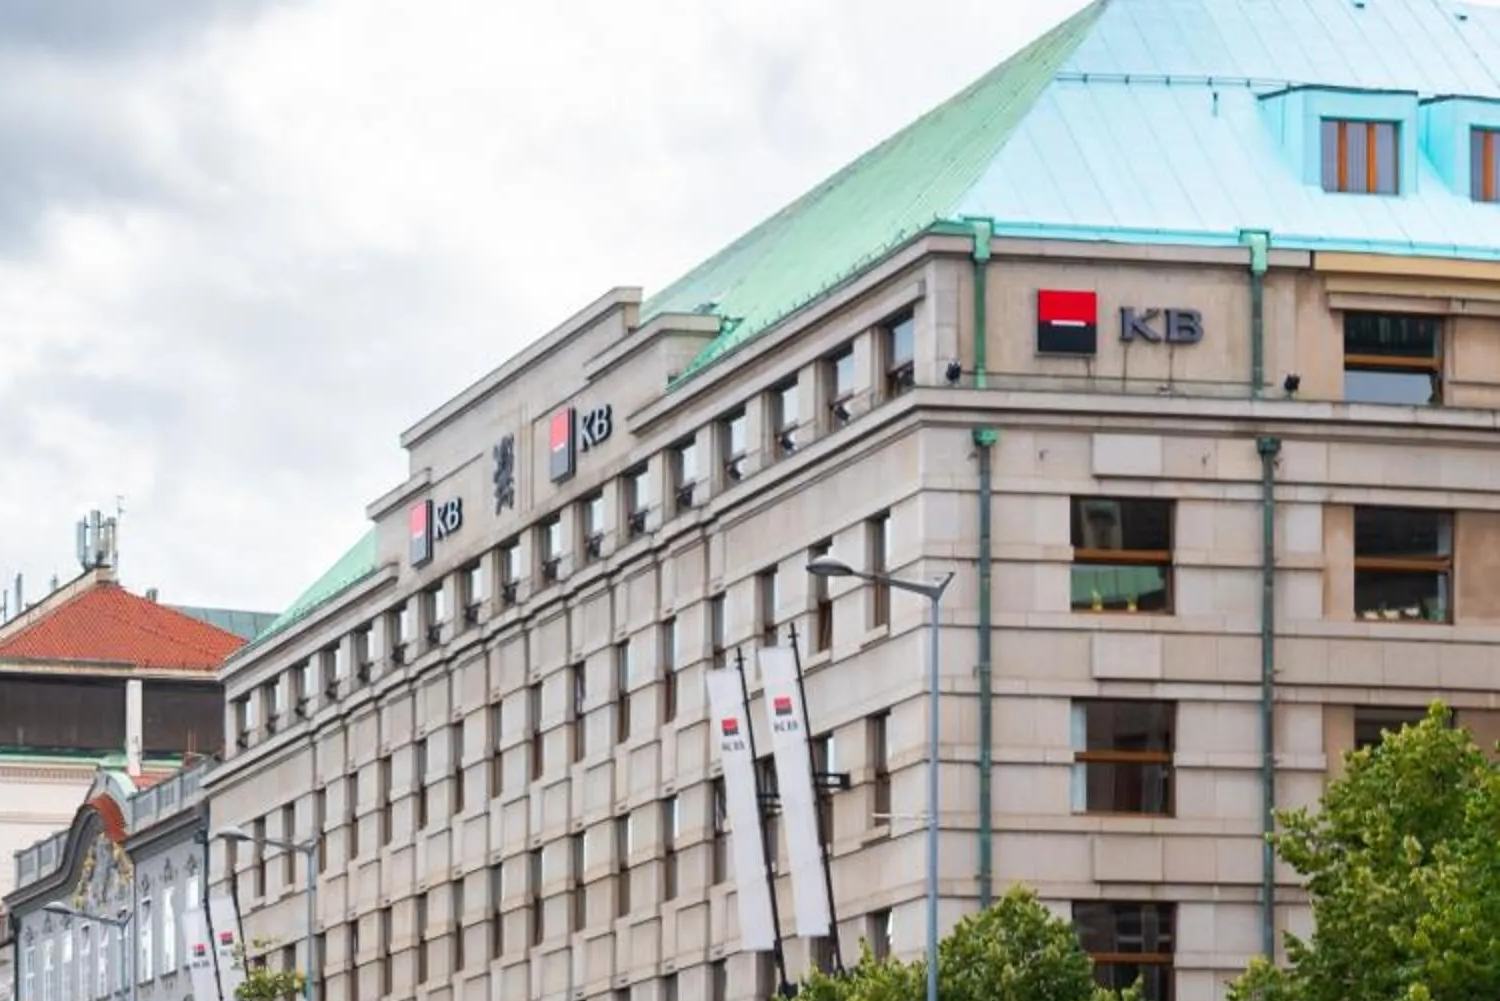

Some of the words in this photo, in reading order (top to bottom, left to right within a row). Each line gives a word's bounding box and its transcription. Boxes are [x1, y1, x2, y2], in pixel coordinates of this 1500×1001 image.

[1119, 306, 1204, 344] KB
[579, 404, 612, 452] KB
[433, 497, 463, 540] KB
